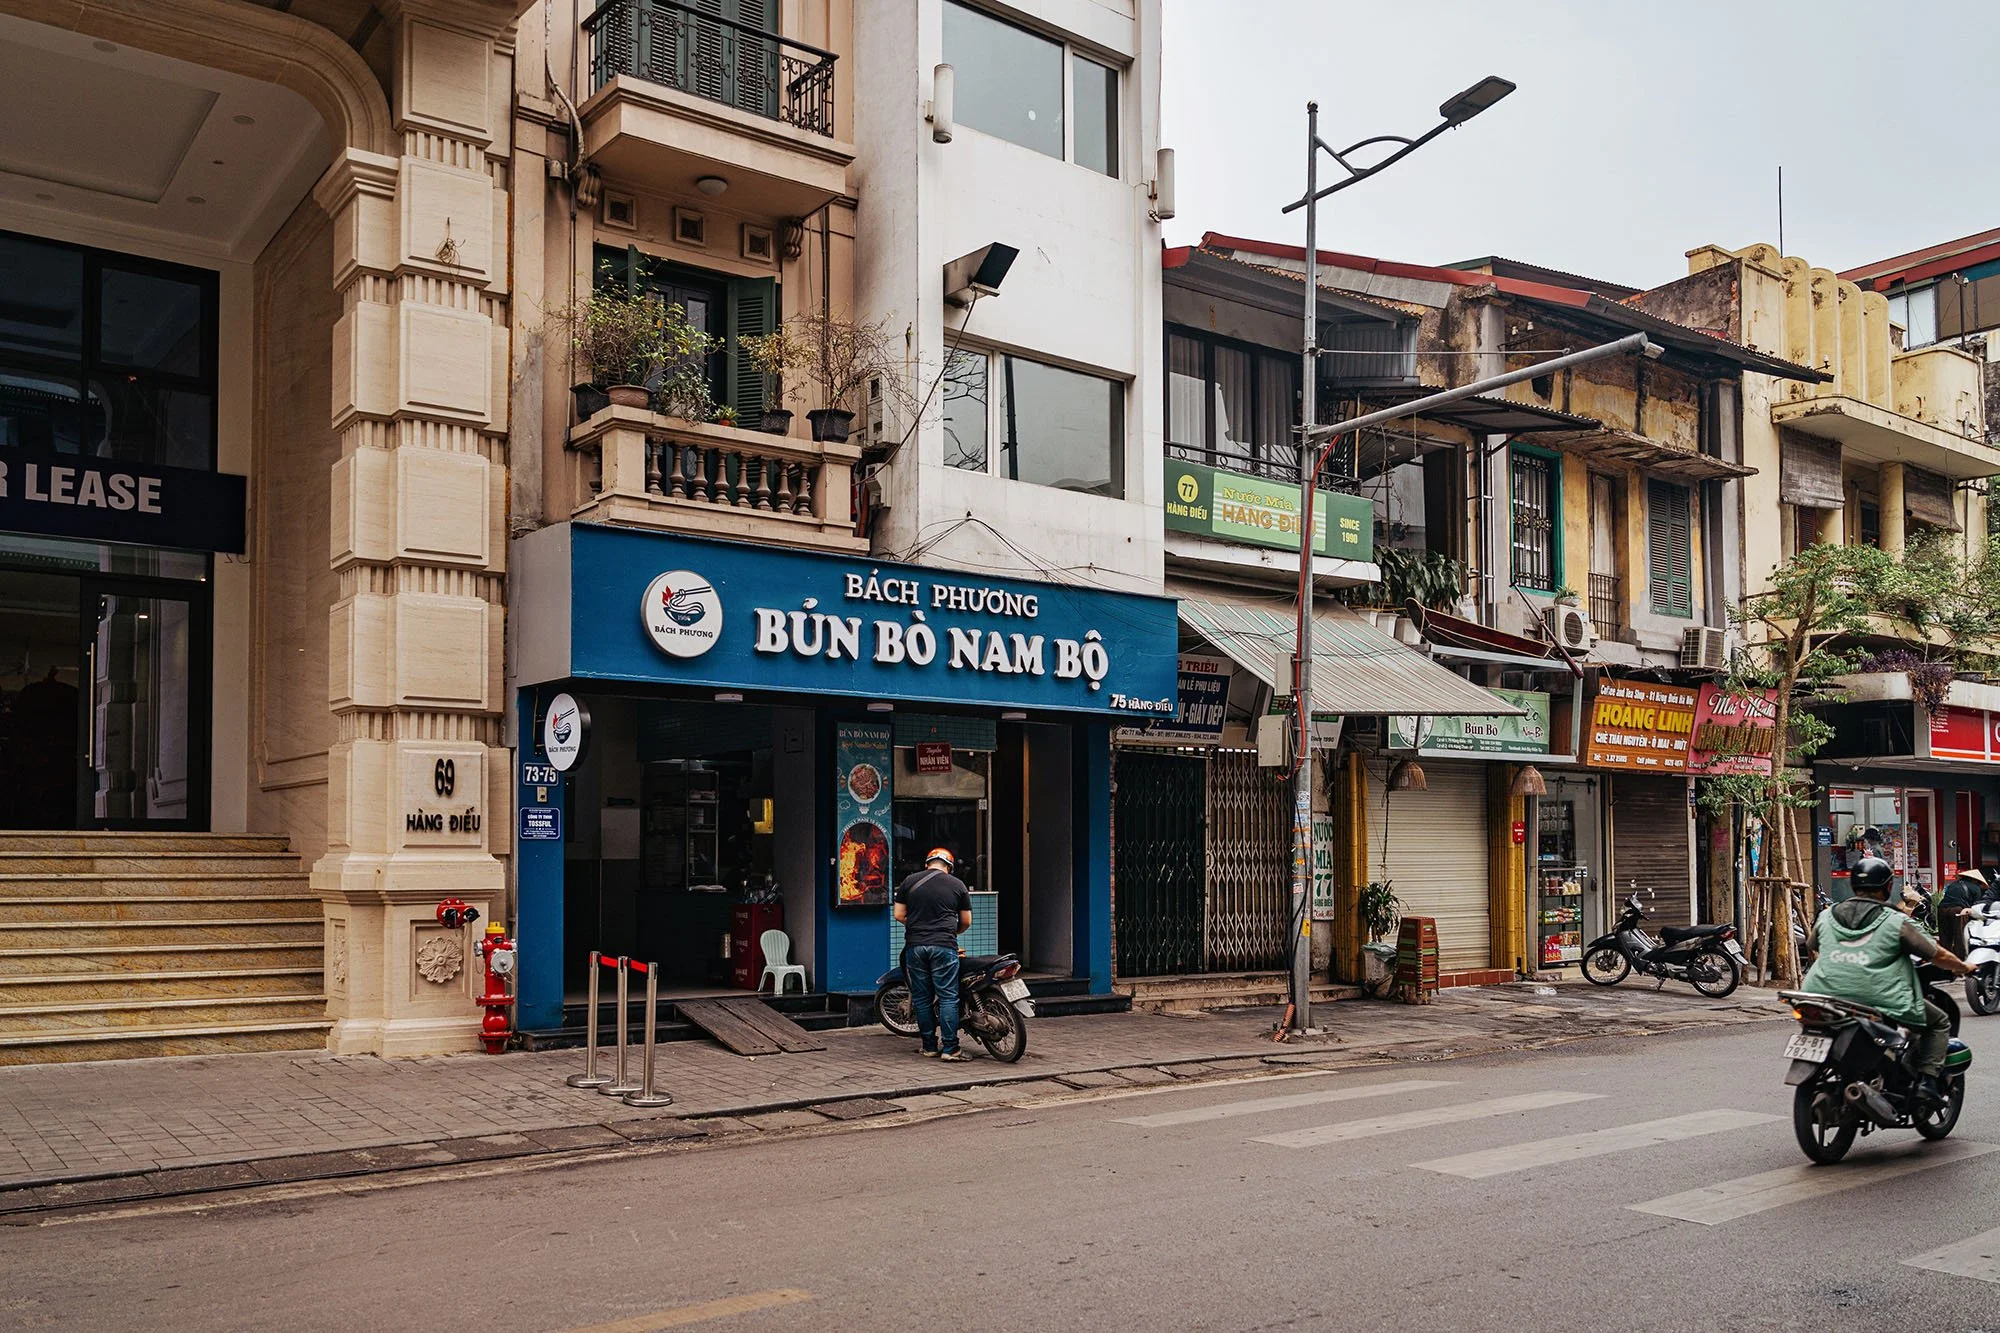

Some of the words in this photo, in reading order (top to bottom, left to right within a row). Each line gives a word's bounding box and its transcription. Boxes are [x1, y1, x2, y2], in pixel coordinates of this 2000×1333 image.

[25, 463, 162, 514] LEASE
[1181, 482, 1195, 497] 77
[1223, 487, 1262, 506] Nước
[1264, 494, 1294, 511] Mía
[1167, 502, 1188, 518] HÀNG
[1189, 504, 1208, 520] ĐIẾU
[1339, 517, 1360, 532] SINCE
[1341, 531, 1358, 545] 1990
[845, 568, 920, 605] BÁCH
[931, 583, 1039, 618] PHƯƠNG
[654, 624, 676, 635] BÁCH
[679, 628, 714, 639] PHƯƠNG
[754, 598, 863, 661] BÚN
[873, 609, 937, 666] BÒ
[947, 626, 1046, 676] NAM
[1054, 629, 1110, 691] BỘ
[1110, 693, 1127, 709] 75
[1128, 697, 1153, 711] HÀNG
[1154, 697, 1174, 712] ĐIẾU
[1708, 692, 1738, 715] Mai
[1207, 700, 1224, 726] DÉP
[1597, 701, 1654, 729] HOÀNG
[1656, 711, 1694, 733] LINH
[1464, 721, 1484, 736] Bún
[1486, 723, 1498, 737] Bò
[1595, 731, 1608, 744] CHÈ
[1623, 735, 1648, 747] NGUYÊN
[1657, 738, 1670, 749] MAI
[919, 755, 935, 765] NHÂN
[936, 755, 949, 766] VIÊN
[434, 758, 455, 796] 69
[525, 765, 557, 783] 73-75
[406, 807, 443, 832] HÀNG
[448, 806, 481, 832] ĐIẾU
[1315, 844, 1333, 869] MÍA
[1314, 873, 1333, 897] 77
[1830, 950, 1870, 965] Grab
[1793, 1035, 1825, 1048] 29-B1
